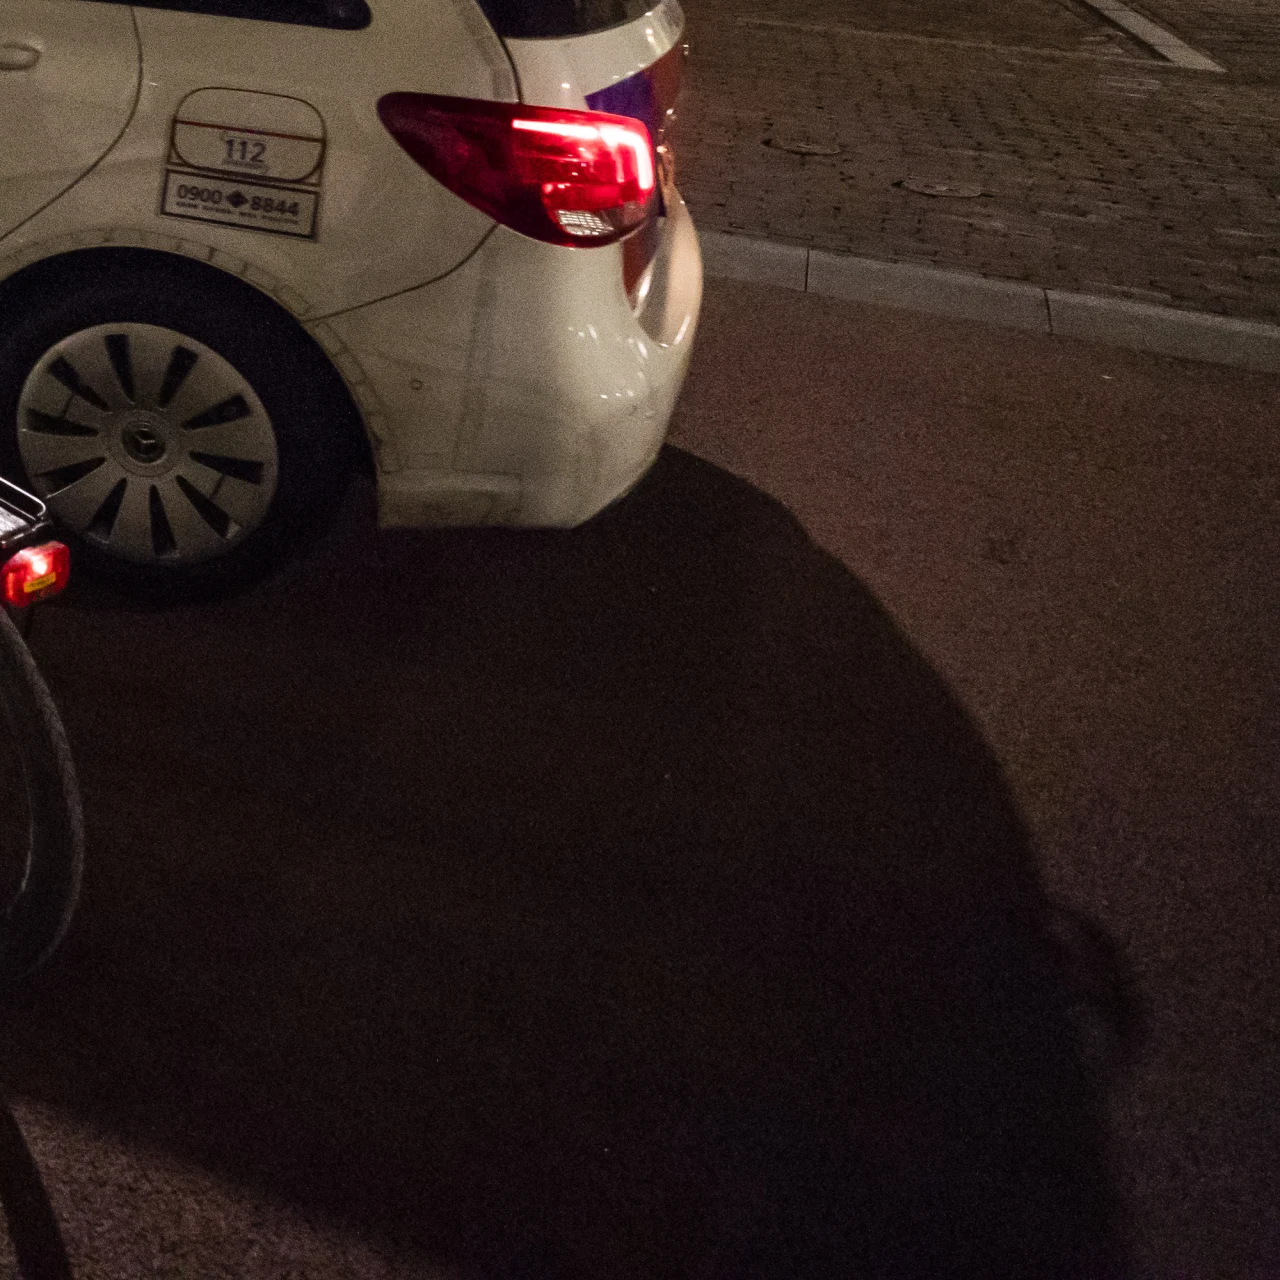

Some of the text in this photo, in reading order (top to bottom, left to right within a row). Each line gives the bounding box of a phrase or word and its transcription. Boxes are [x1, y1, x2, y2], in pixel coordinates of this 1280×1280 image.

[225, 138, 266, 163] 112
[177, 184, 222, 205] 0900
[251, 195, 299, 216] 8844
